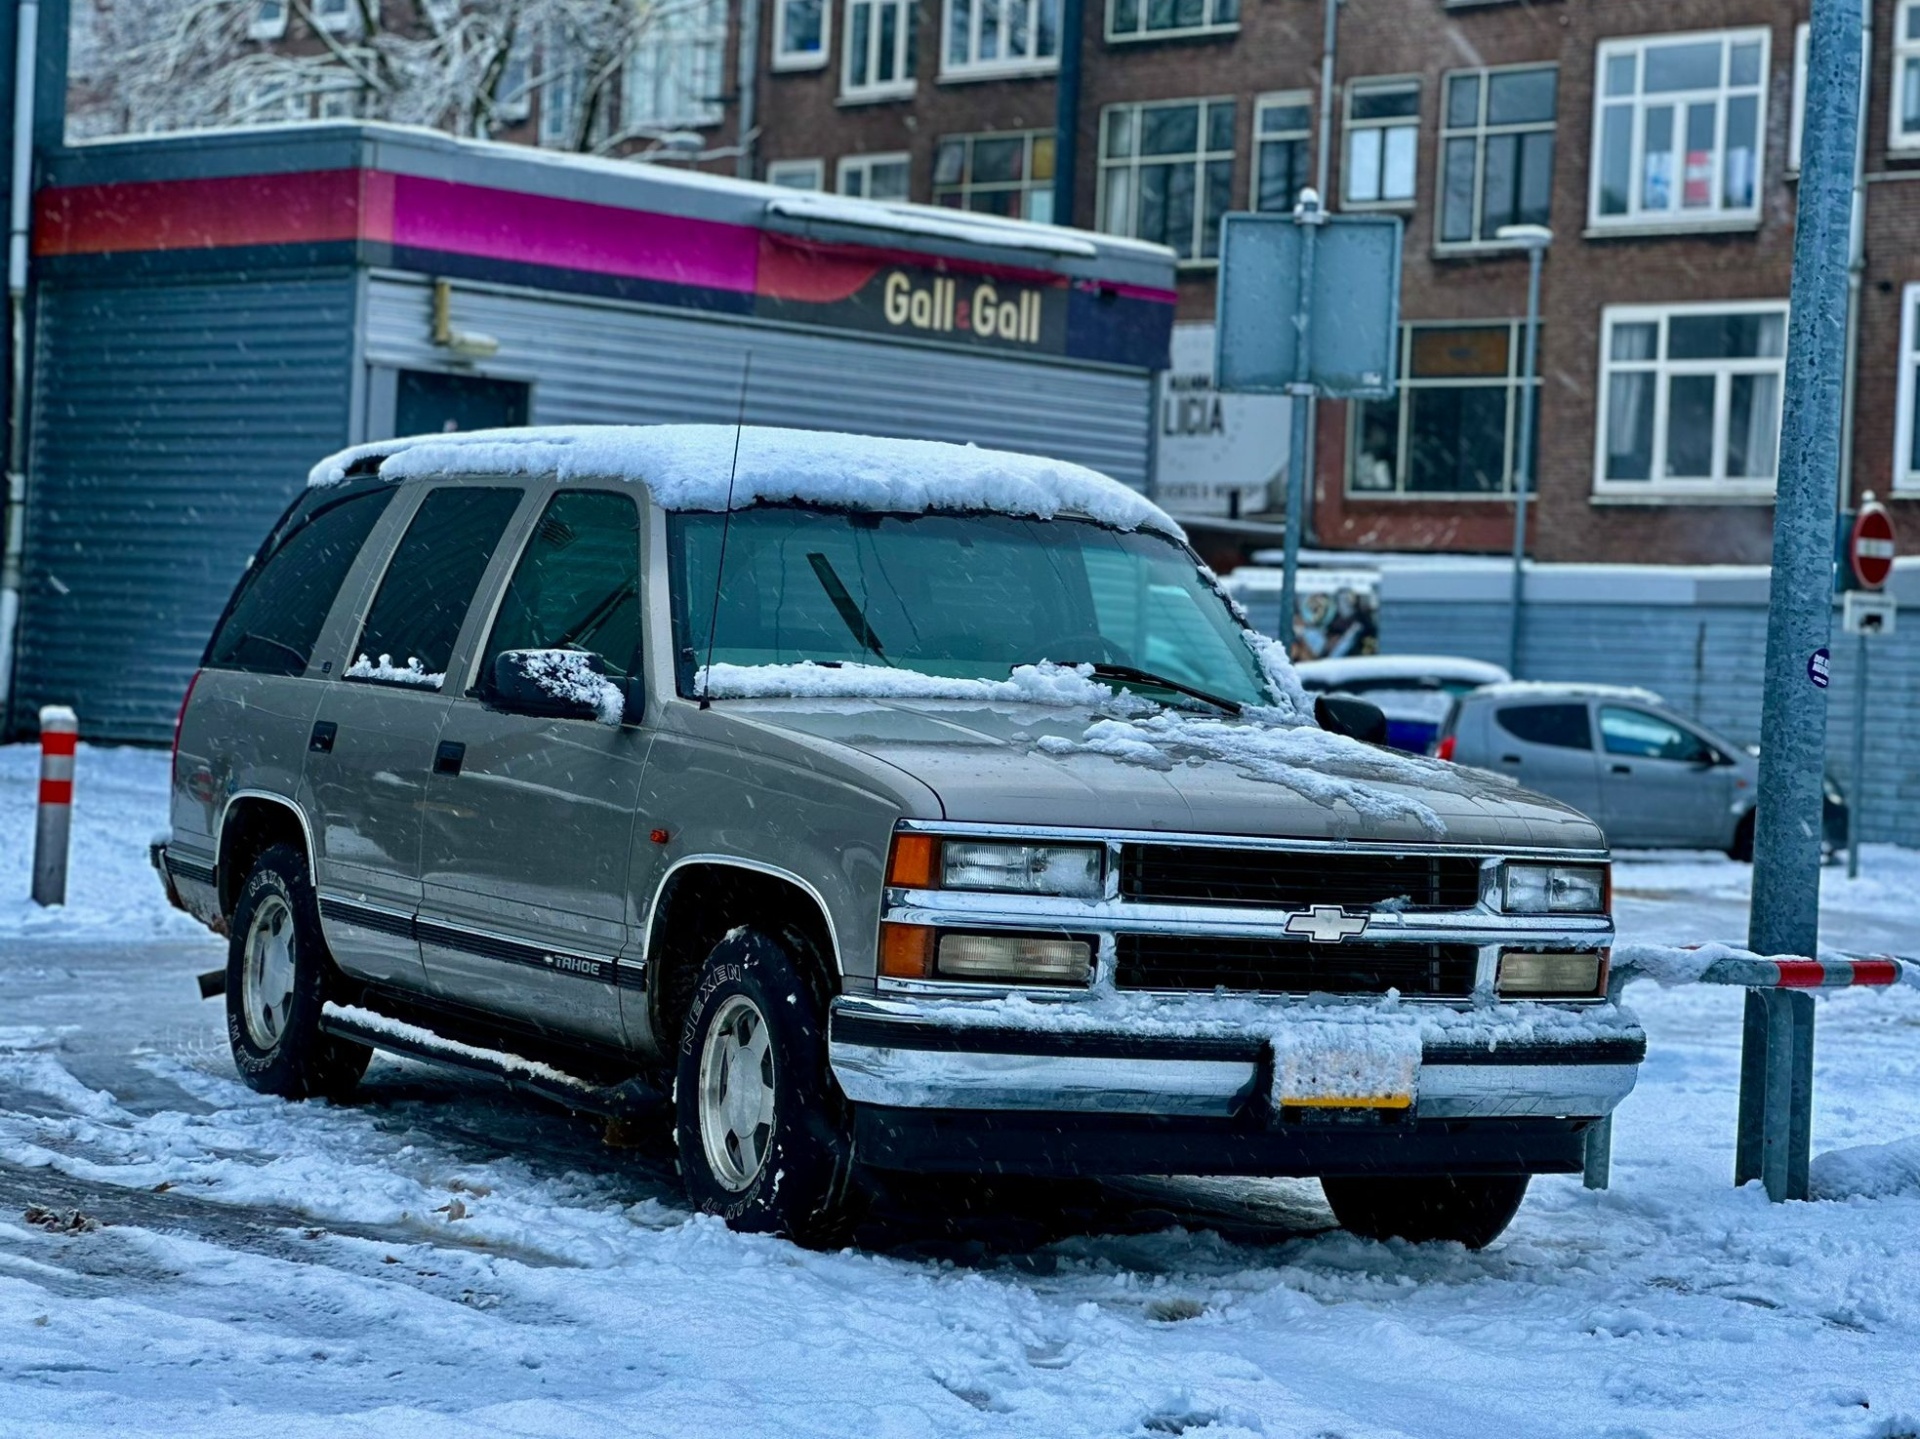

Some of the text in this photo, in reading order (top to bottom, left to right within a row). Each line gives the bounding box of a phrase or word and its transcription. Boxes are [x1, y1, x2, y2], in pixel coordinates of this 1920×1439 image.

[884, 271, 955, 332] Gall
[972, 284, 1042, 344] Gall
[554, 954, 601, 976] TAHOE
[682, 963, 742, 1056] NEXEN
